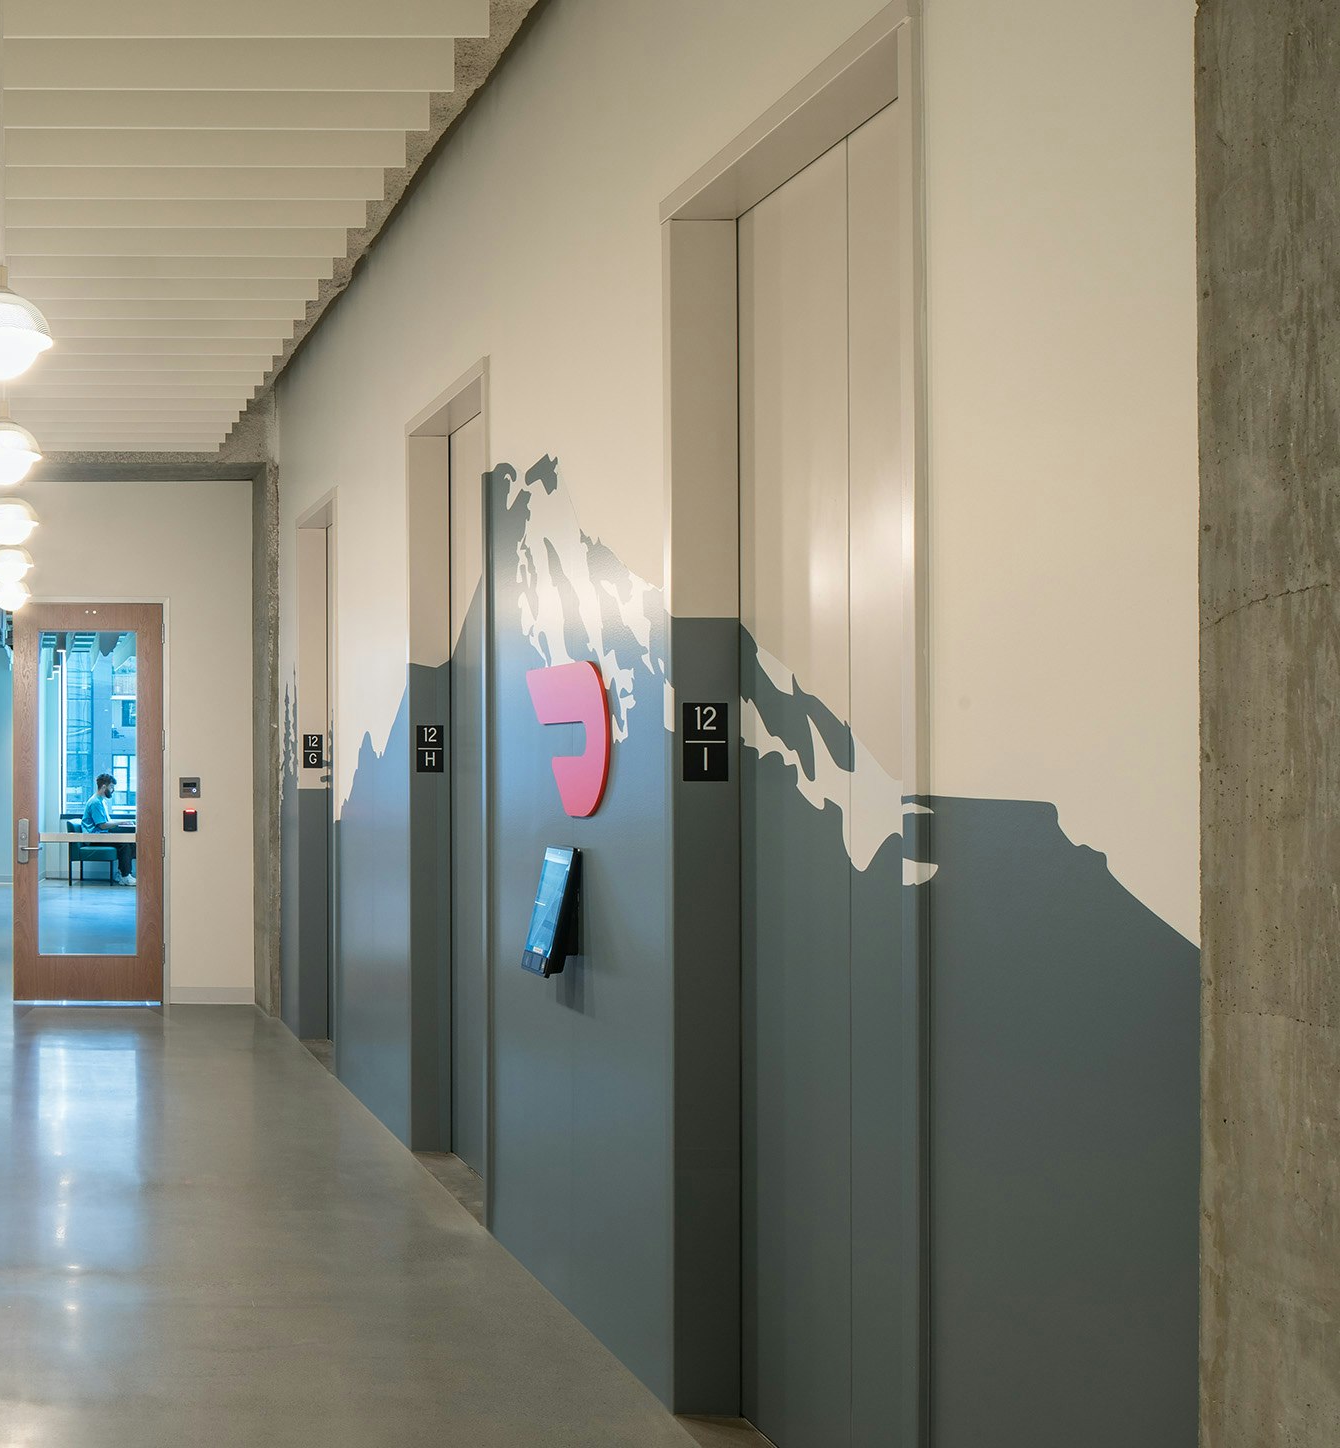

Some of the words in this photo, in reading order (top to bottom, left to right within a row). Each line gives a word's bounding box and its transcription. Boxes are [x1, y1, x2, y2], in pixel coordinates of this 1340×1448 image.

[694, 706, 717, 730] 12
[308, 735, 319, 747] 12
[423, 727, 437, 742] 12
[308, 752, 318, 765] G
[425, 751, 436, 767] H
